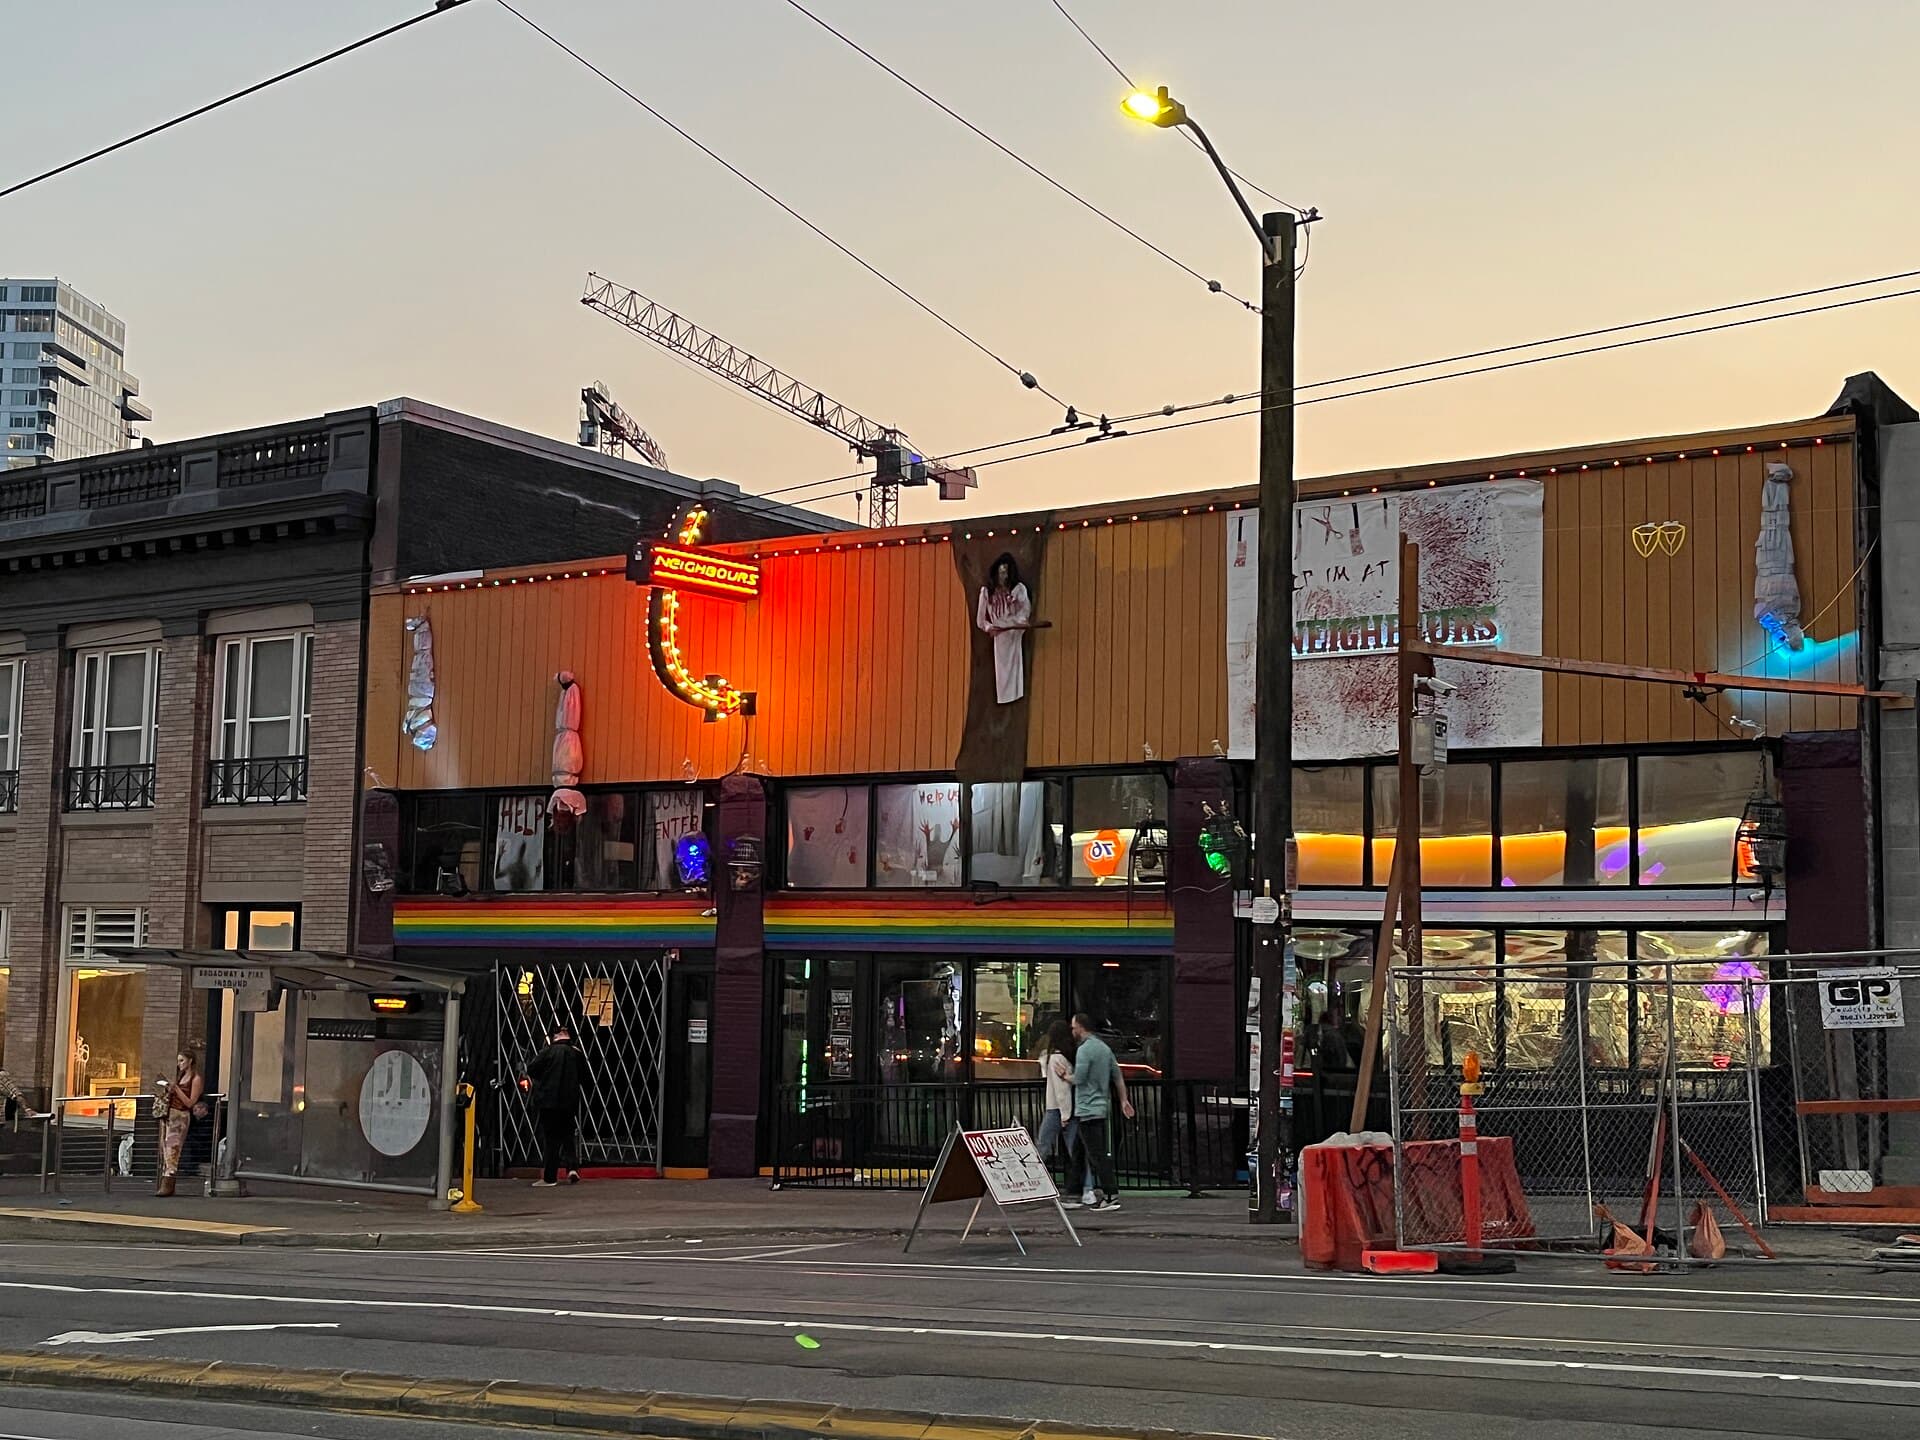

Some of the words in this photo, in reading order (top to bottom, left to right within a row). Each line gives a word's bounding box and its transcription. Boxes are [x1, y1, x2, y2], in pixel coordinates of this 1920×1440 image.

[655, 556, 759, 586] NEIGHBOURS
[1326, 565, 1350, 582] IM
[1362, 560, 1390, 582] AT
[501, 795, 544, 836] HELP
[1828, 979, 1890, 1006] GP
[968, 1136, 988, 1154] NO
[988, 1133, 1029, 1149] PARKING
